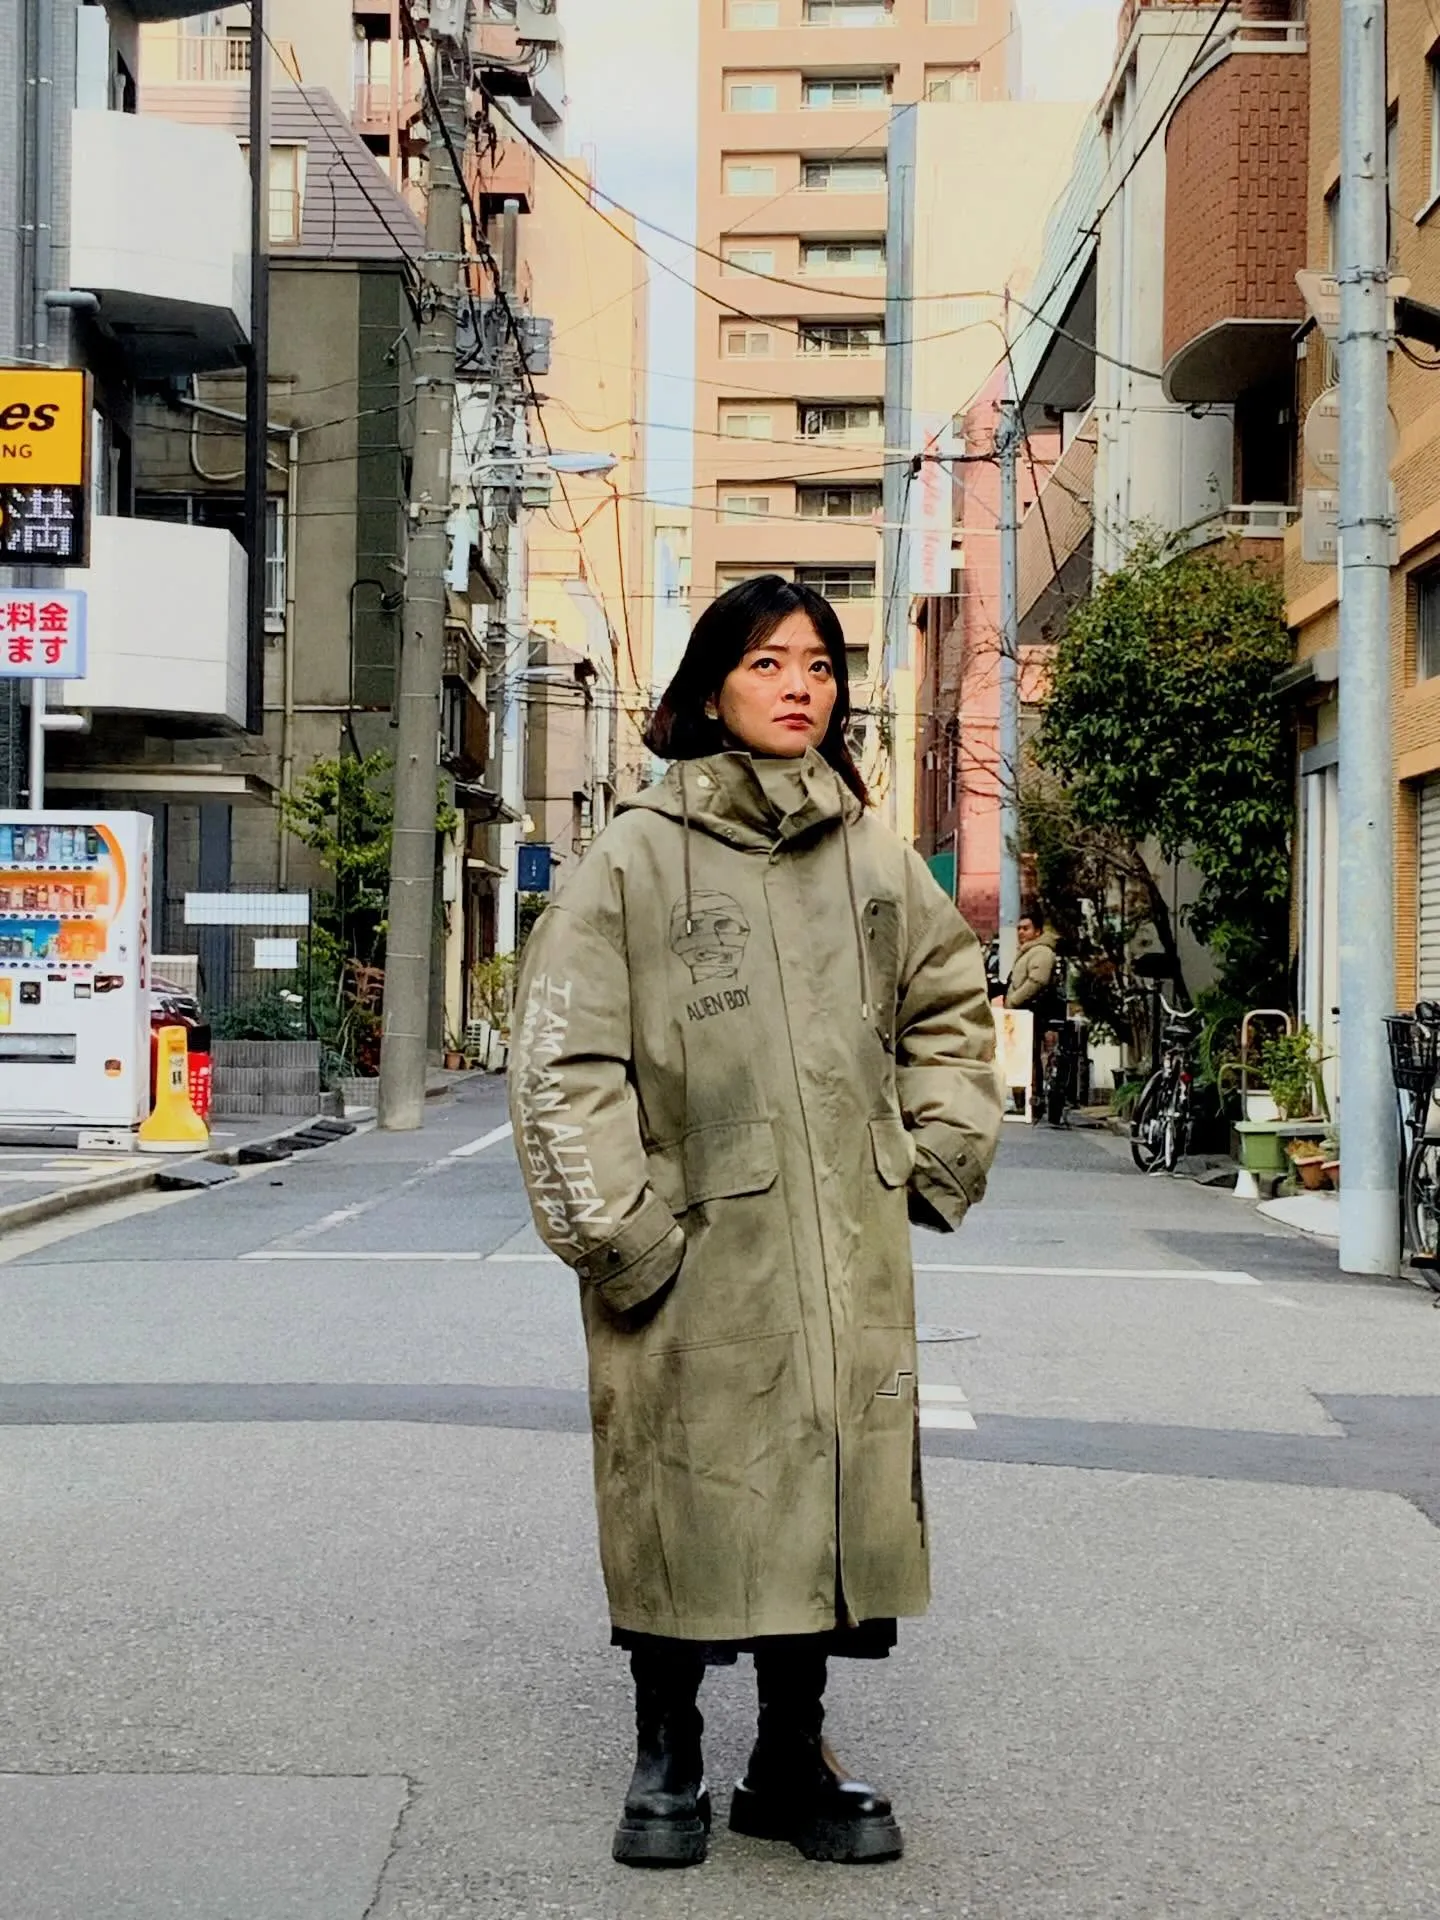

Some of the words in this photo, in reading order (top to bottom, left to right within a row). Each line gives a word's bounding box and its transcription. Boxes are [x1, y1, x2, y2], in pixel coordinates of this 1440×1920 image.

[2, 443, 33, 458] NG
[0, 602, 68, 632] 料金
[8, 636, 68, 664] ます
[686, 992, 725, 1021] ALIEN
[723, 984, 751, 1010] BOY
[535, 1120, 613, 1225] ALIEN
[534, 1195, 585, 1252] BOY
